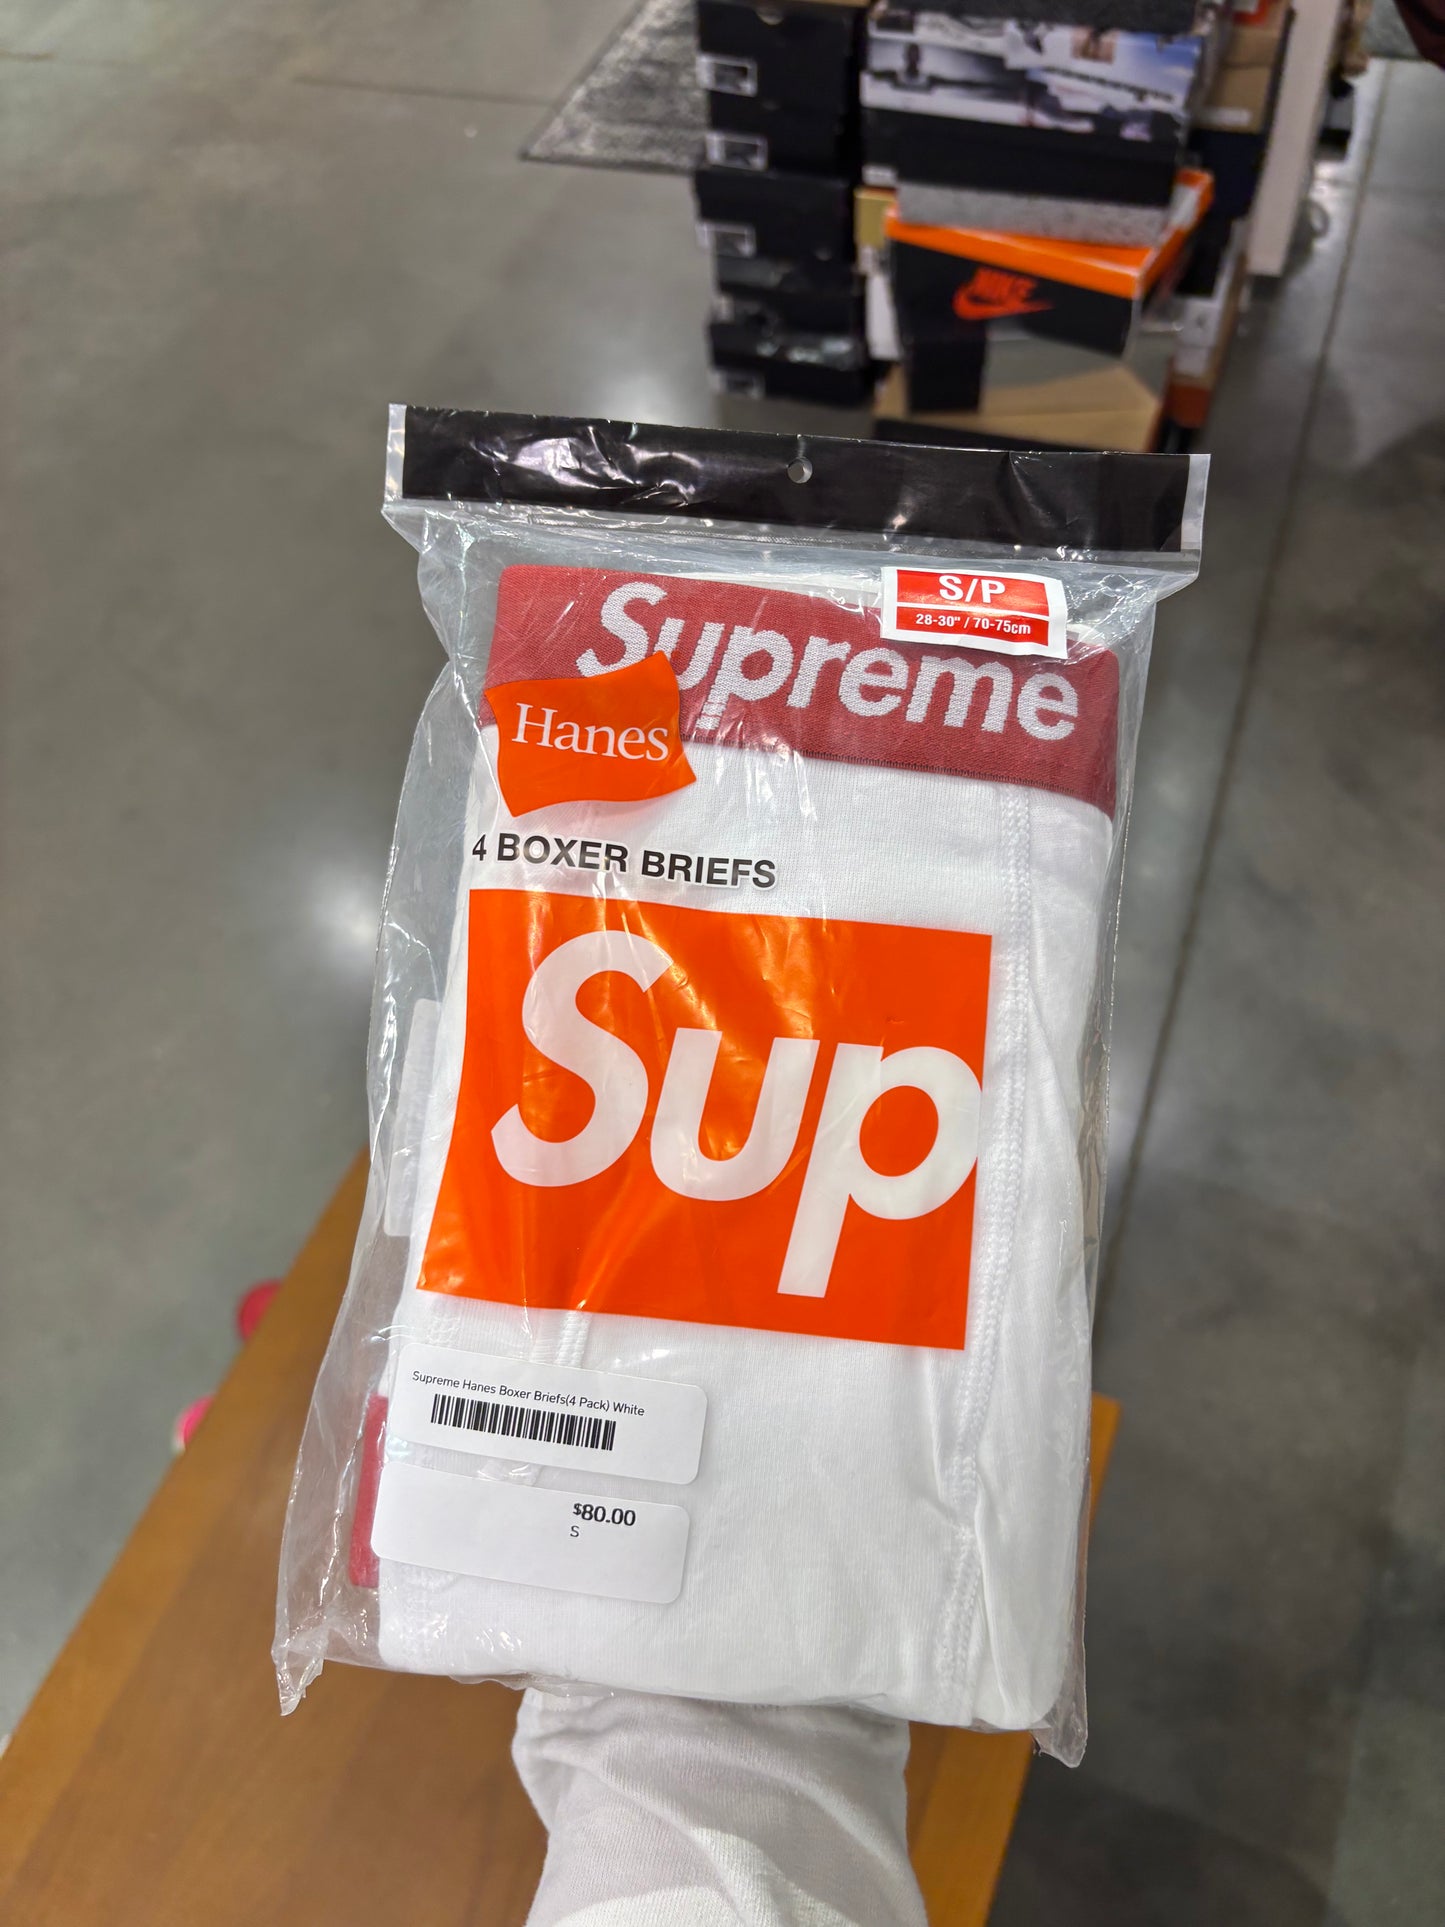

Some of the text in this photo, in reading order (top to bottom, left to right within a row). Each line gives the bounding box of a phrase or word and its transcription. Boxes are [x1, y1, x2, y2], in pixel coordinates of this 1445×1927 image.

[938, 574, 1006, 604] S/P
[915, 613, 1031, 635] 28-30" / 70-75cm
[575, 581, 1078, 741] Supreme
[511, 702, 669, 761] Hanes
[471, 832, 776, 888] 4 BOXER BRIEFS
[490, 929, 983, 1298] Sup
[412, 1370, 460, 1388] Supreme
[462, 1379, 496, 1394] Hanes
[499, 1385, 532, 1400] Boxer
[579, 1397, 610, 1412] Pack)
[613, 1402, 645, 1417] White
[569, 1526, 580, 1538] S
[572, 1502, 637, 1527] $80.00
